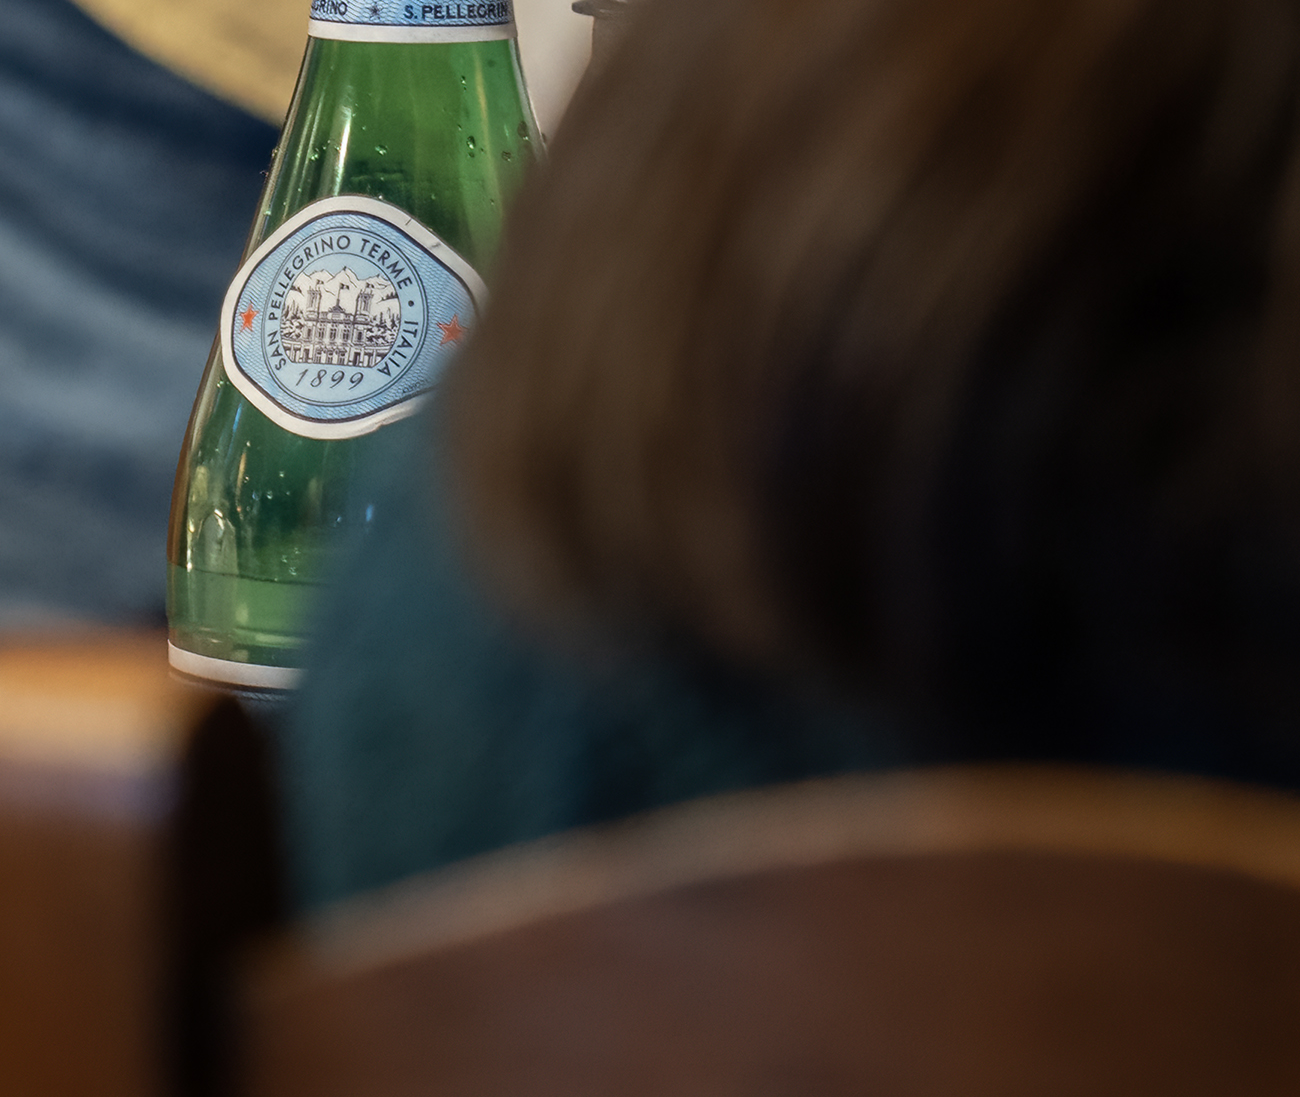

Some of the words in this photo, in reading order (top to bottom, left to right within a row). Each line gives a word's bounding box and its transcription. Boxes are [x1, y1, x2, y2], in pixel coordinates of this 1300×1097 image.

[268, 235, 351, 321] PELLEGRINO
[360, 238, 413, 290] TERME
[268, 328, 287, 370] SAN
[377, 319, 419, 377] ITALIA
[296, 368, 364, 390] 1899
